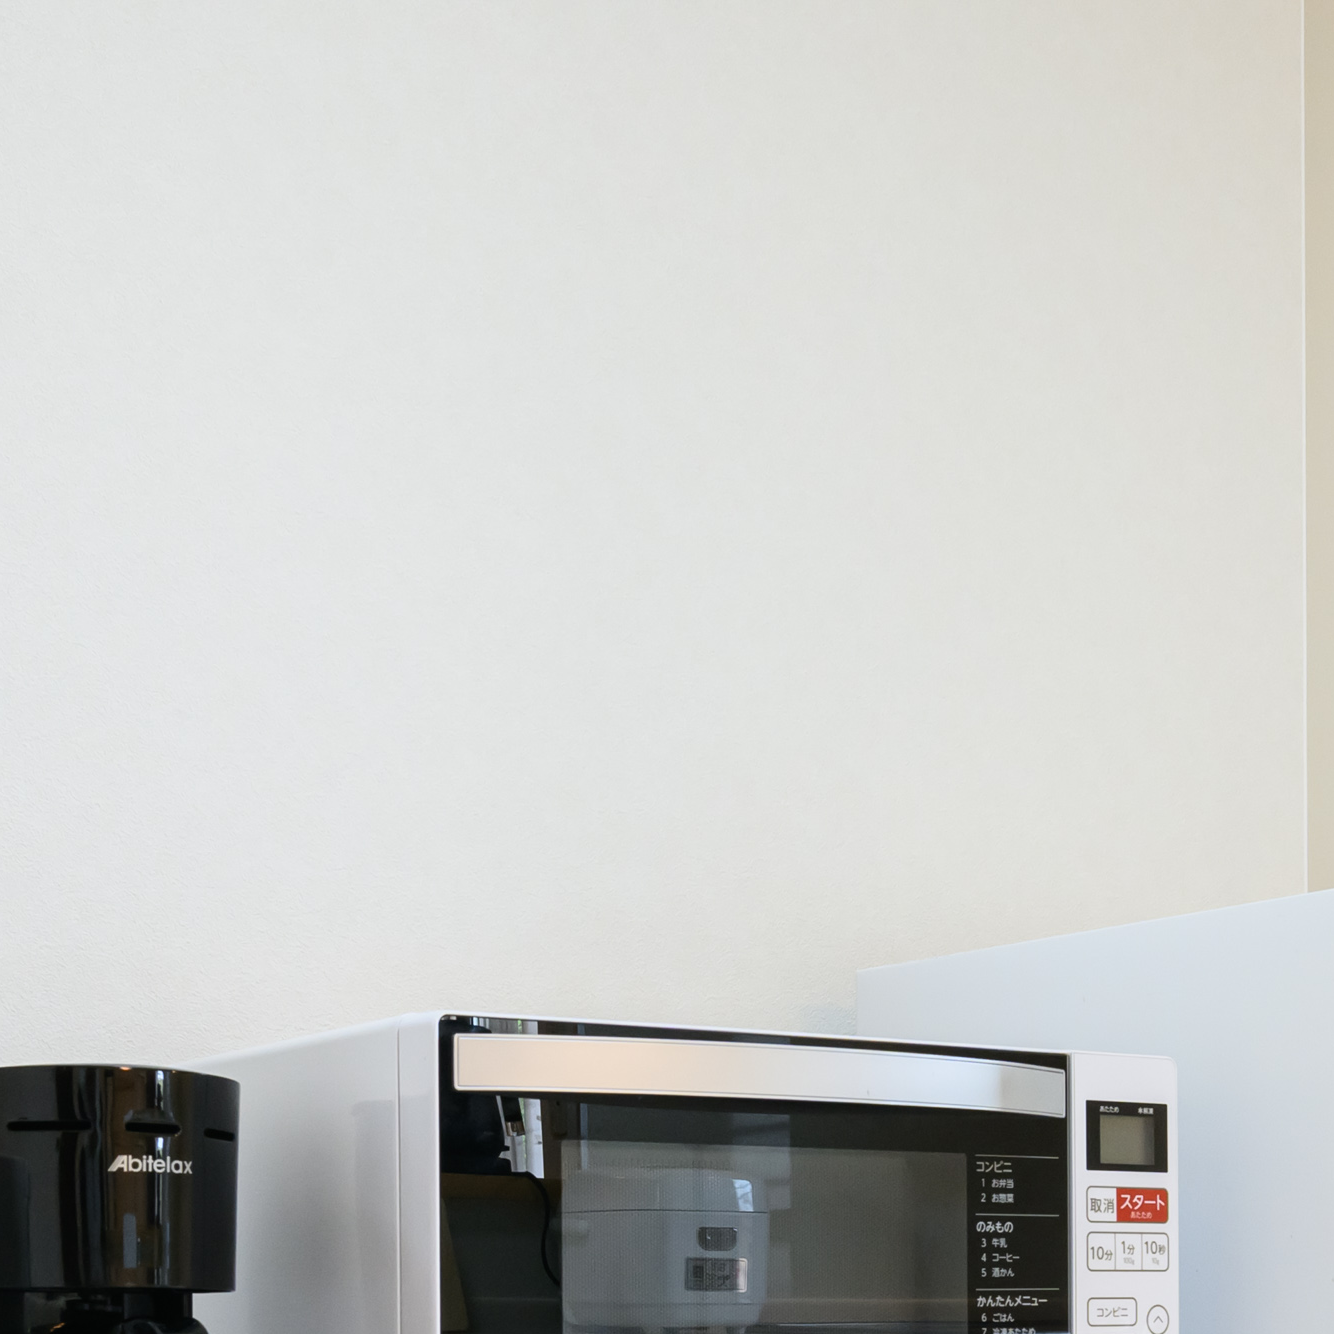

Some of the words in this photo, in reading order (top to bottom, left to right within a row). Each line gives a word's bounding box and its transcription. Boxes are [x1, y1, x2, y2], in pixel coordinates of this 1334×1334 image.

[107, 1154, 193, 1174] Abitelax
[976, 1160, 1012, 1173] コンビニ
[981, 1178, 985, 1188] 1
[991, 1178, 1014, 1189] お弁当
[980, 1192, 986, 1203] 2
[1120, 1194, 1166, 1211] スタート
[1090, 1197, 1115, 1214] 取消
[976, 1221, 1014, 1233] のみもの
[981, 1238, 987, 1248] 3
[991, 1237, 1008, 1248] 牛乳
[1121, 1240, 1135, 1255] 1分
[981, 1253, 987, 1262] 4
[992, 1252, 1020, 1262] コーヒー
[1090, 1246, 1113, 1261] 10分
[981, 1268, 987, 1277] 5
[991, 1267, 1015, 1278] 酒かん
[977, 1295, 1048, 1307] かんたんメニュー
[981, 1313, 987, 1322] 6
[992, 1312, 1015, 1322] ごはん
[1096, 1306, 1129, 1318] コンビニ
